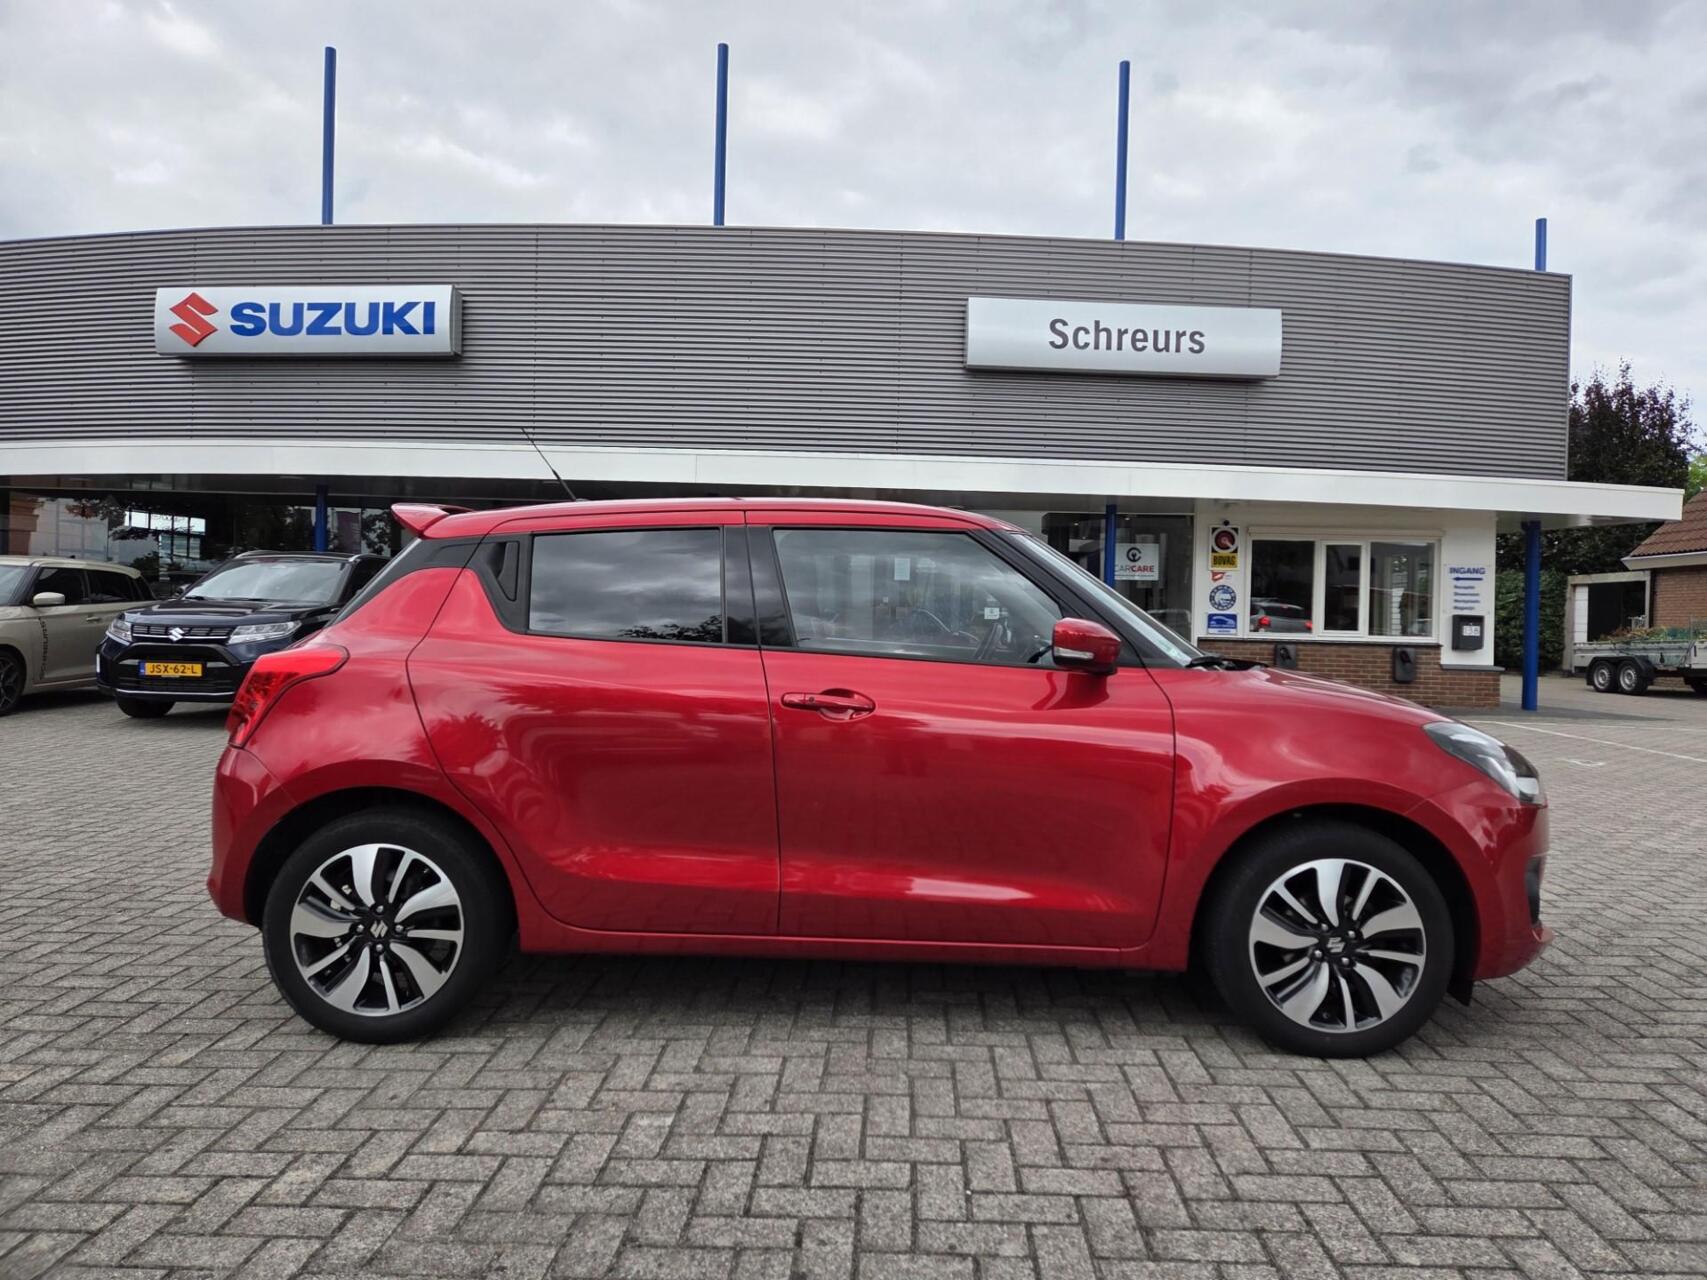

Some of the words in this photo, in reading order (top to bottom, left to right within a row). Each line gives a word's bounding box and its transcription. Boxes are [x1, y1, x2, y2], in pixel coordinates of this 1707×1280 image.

[230, 301, 436, 336] SUZUKI
[1048, 318, 1206, 354] Schreurs
[1449, 567, 1486, 575] INGANG
[150, 664, 198, 674] JSX-62-L
